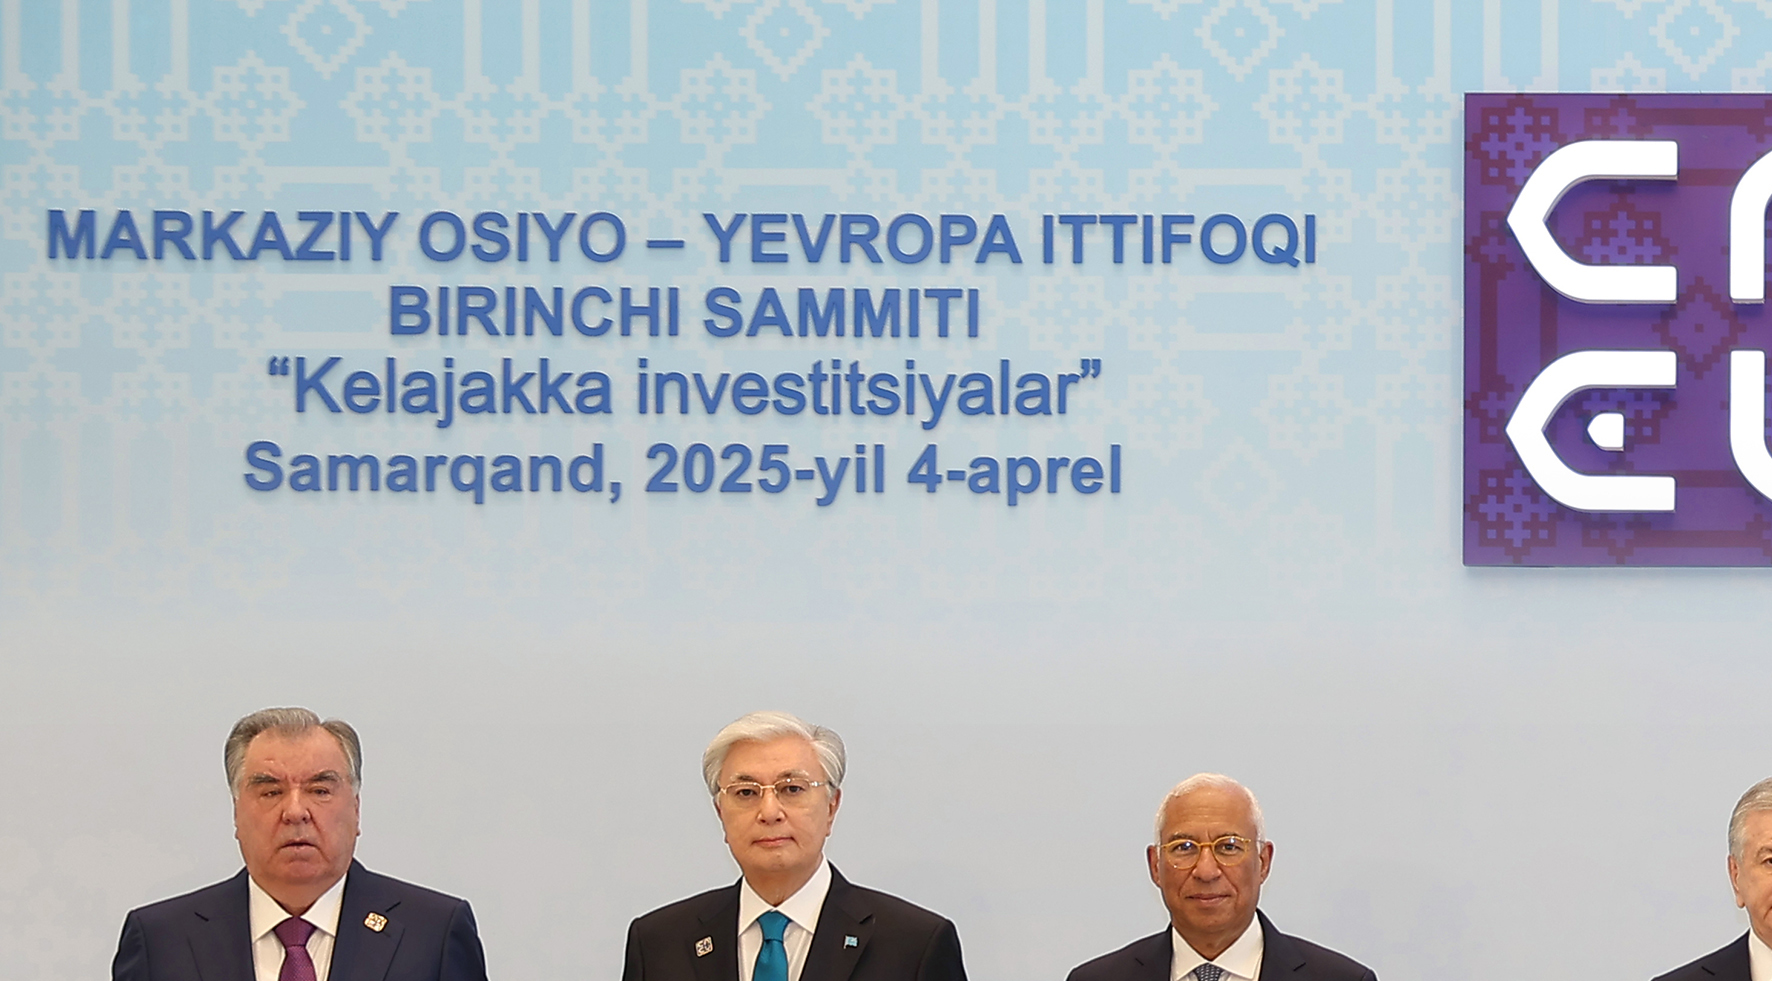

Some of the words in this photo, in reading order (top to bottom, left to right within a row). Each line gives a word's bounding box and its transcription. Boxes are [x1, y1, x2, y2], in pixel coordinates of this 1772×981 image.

[47, 209, 400, 262] MARKAZIY
[419, 211, 626, 264] OSIYO
[702, 213, 1023, 265] YEVROPA
[1042, 213, 1316, 269] ITTIFOQI
[390, 285, 679, 338] BIRINCHI
[703, 286, 979, 338] SAMMITI
[268, 356, 613, 429] “Kelajakka
[638, 357, 1102, 431] investitsiyalar”
[244, 441, 621, 505] Samarqand,
[645, 442, 884, 507] 2025-yil
[907, 444, 1121, 507] 4-aprel
